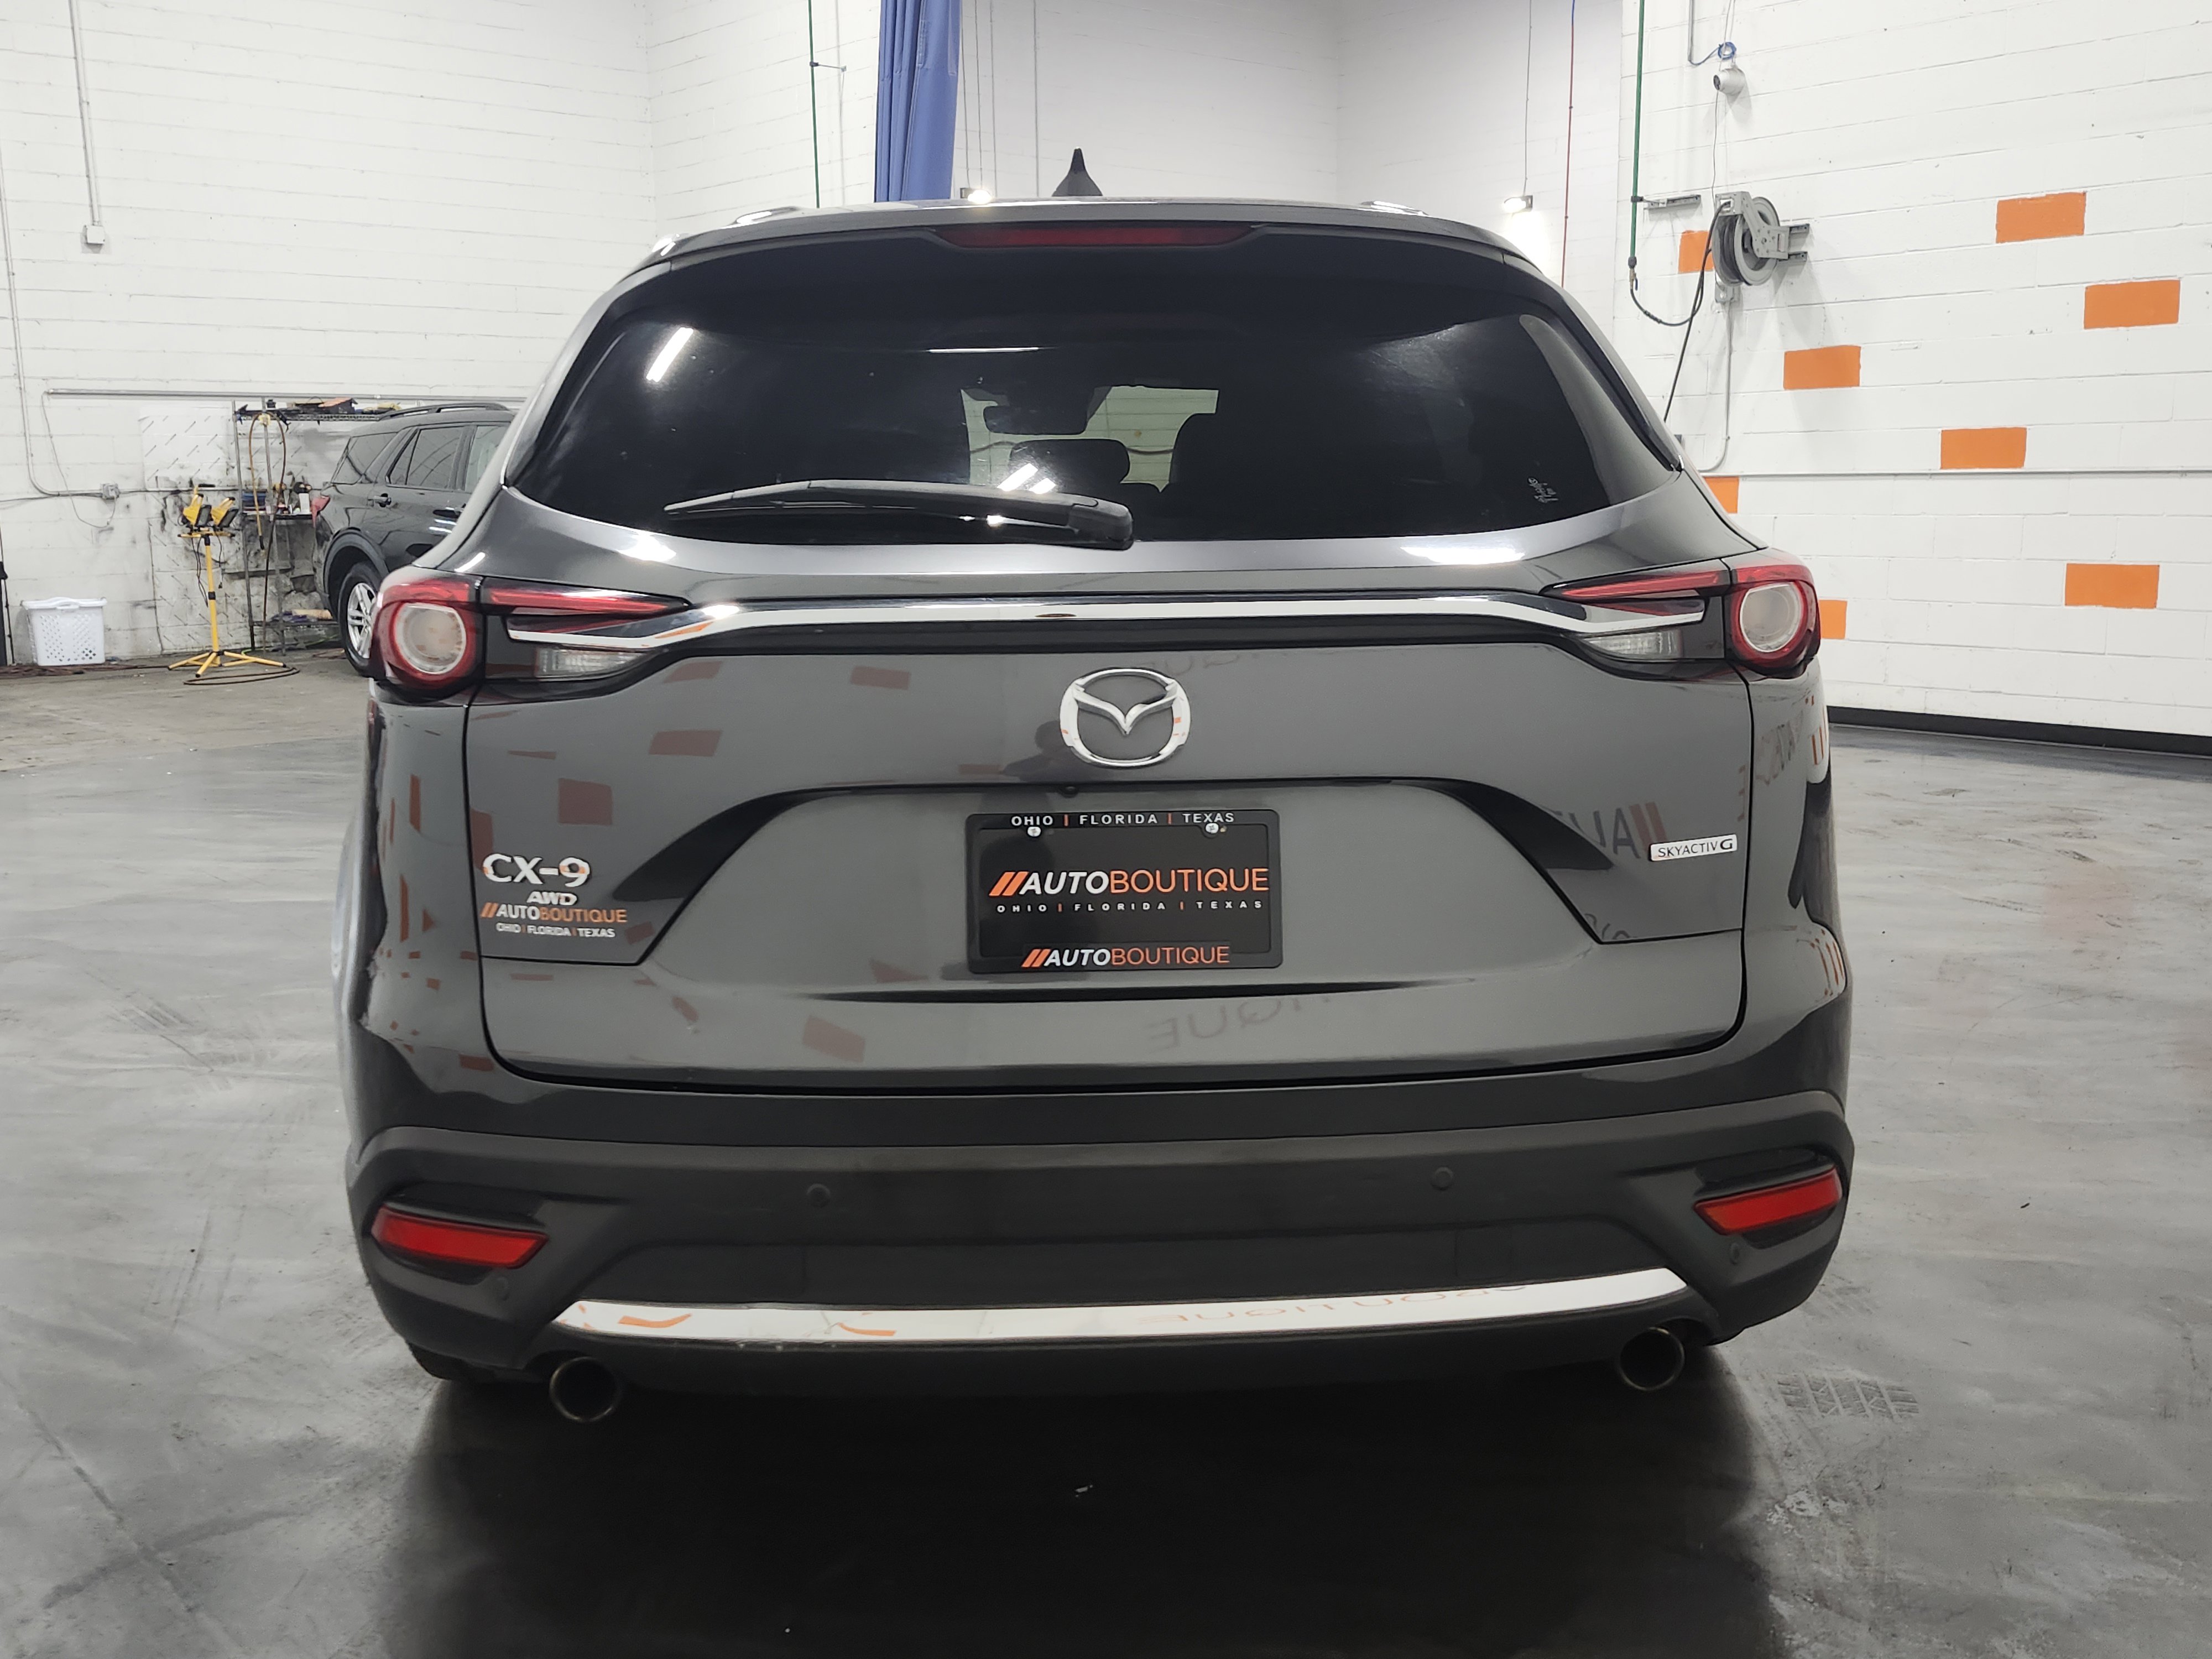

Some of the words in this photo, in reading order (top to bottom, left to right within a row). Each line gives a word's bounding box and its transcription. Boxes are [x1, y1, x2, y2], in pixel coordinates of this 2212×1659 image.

[1011, 815, 1053, 826] OHIO
[1079, 813, 1158, 825] FLORIDA
[1182, 812, 1235, 823] TEXAS
[482, 853, 591, 887] CX-9
[1019, 868, 1270, 895] AUTOBOUTIQUE
[526, 891, 577, 906] AWD
[997, 904, 1047, 913] OHIO
[1074, 902, 1166, 911] FLORIDA
[1196, 900, 1262, 910] TEXAS
[496, 904, 628, 923] AUTOBOUTIQUE
[496, 922, 521, 933] OHIO
[527, 925, 572, 936] FLORIDA
[577, 927, 615, 938] TEXAS
[1044, 946, 1230, 967] AUTOBOUTIQUE
